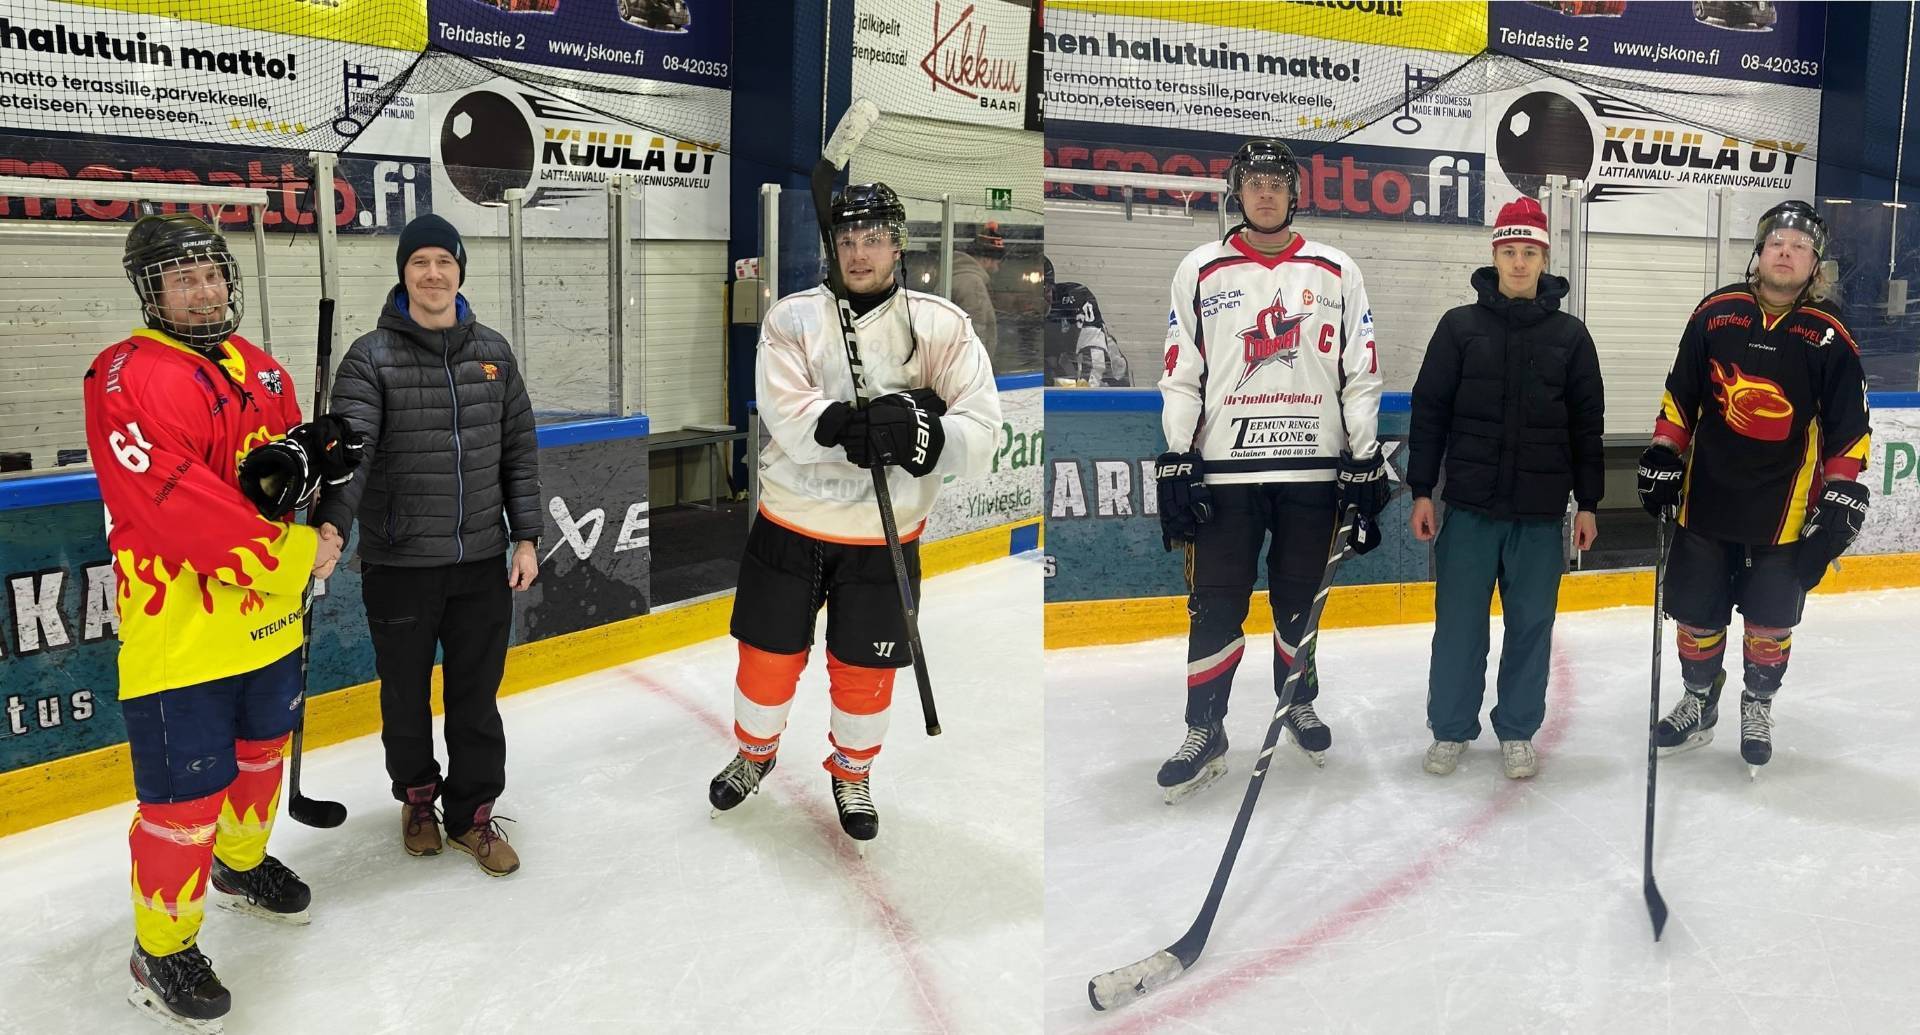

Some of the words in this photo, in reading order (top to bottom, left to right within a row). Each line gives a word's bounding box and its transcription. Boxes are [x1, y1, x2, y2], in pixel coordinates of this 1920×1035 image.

[857, 12, 900, 38] jälkipelit
[0, 18, 172, 67] halutuin
[181, 48, 297, 81] matto!
[439, 22, 511, 48] Tehdastie
[515, 33, 525, 50] 2
[548, 39, 644, 65] www.jskone.fi
[662, 55, 728, 77] 08-420353
[920, 0, 1022, 99] Kukkuu
[1108, 33, 1250, 73] halutuin
[1257, 54, 1360, 83] matto!
[1499, 27, 1574, 50] Tehdastie
[1578, 36, 1589, 52] 2
[1613, 40, 1719, 66] www.jskone.fi
[1741, 53, 1818, 76] 08-420353
[384, 107, 415, 120] FINLAND
[980, 97, 1021, 112] BAARI
[1412, 104, 1432, 116] MADE
[1434, 106, 1441, 117] IN
[1442, 107, 1472, 119] FINLAND
[1435, 94, 1472, 107] SUOMESSA
[541, 127, 665, 172] KUULA
[672, 139, 721, 175] OY
[1601, 126, 1742, 171] KUULA
[1749, 139, 1808, 175] OY
[1599, 166, 1675, 182] LATTIANVALU-
[1677, 170, 1690, 183] JA
[1693, 172, 1791, 189] RAKENNUSPALVELU
[1318, 323, 1335, 353] C
[1248, 433, 1265, 443] JA
[1269, 432, 1303, 443] KONE
[1230, 450, 1266, 458] Oulainen
[1272, 448, 1292, 457] 0400
[965, 486, 1033, 518] Ylivieska
[250, 616, 288, 641] VETELIN
